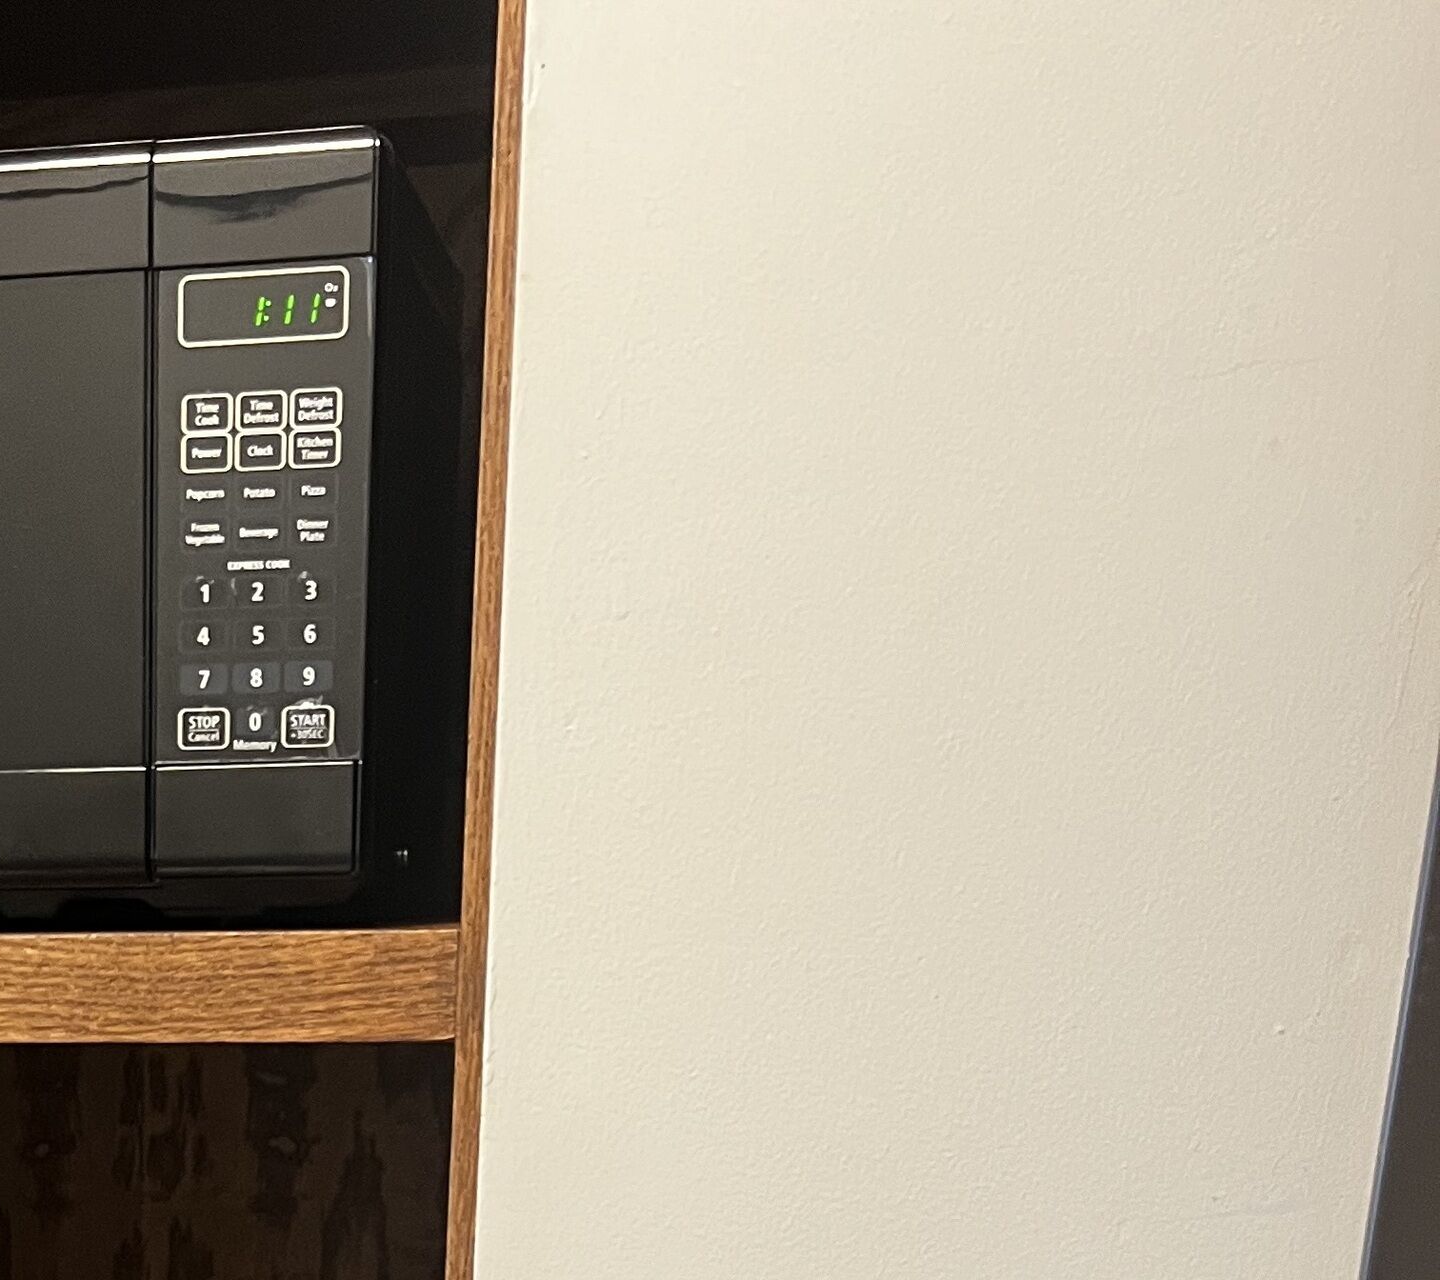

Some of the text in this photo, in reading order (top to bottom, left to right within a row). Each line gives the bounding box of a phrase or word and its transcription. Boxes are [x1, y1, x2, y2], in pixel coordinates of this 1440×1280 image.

[254, 292, 321, 327] 1:11
[195, 402, 219, 413] Time
[250, 399, 274, 411] Time
[298, 396, 333, 409] Weight
[194, 415, 219, 427] Cook
[243, 411, 279, 424] Defrost
[297, 409, 334, 422] Defrost
[297, 436, 333, 448] Kitchen
[191, 446, 222, 458] Power
[247, 444, 274, 457] Clock
[301, 449, 329, 460] Timer
[186, 489, 225, 501] Popcorn
[301, 485, 326, 496] Pizza
[300, 531, 325, 541] Plate
[200, 584, 210, 603] 1
[251, 582, 264, 601] 2
[305, 580, 318, 600] 3
[196, 627, 210, 645] 4
[252, 625, 265, 645] 5
[303, 624, 317, 643] 6
[198, 669, 210, 689] 7
[250, 667, 263, 687] 8
[303, 666, 315, 686] 9
[188, 715, 220, 729] STOP
[248, 712, 262, 731] 0
[290, 713, 326, 728] START
[187, 731, 220, 742] Cancel
[233, 739, 277, 752] Memory
